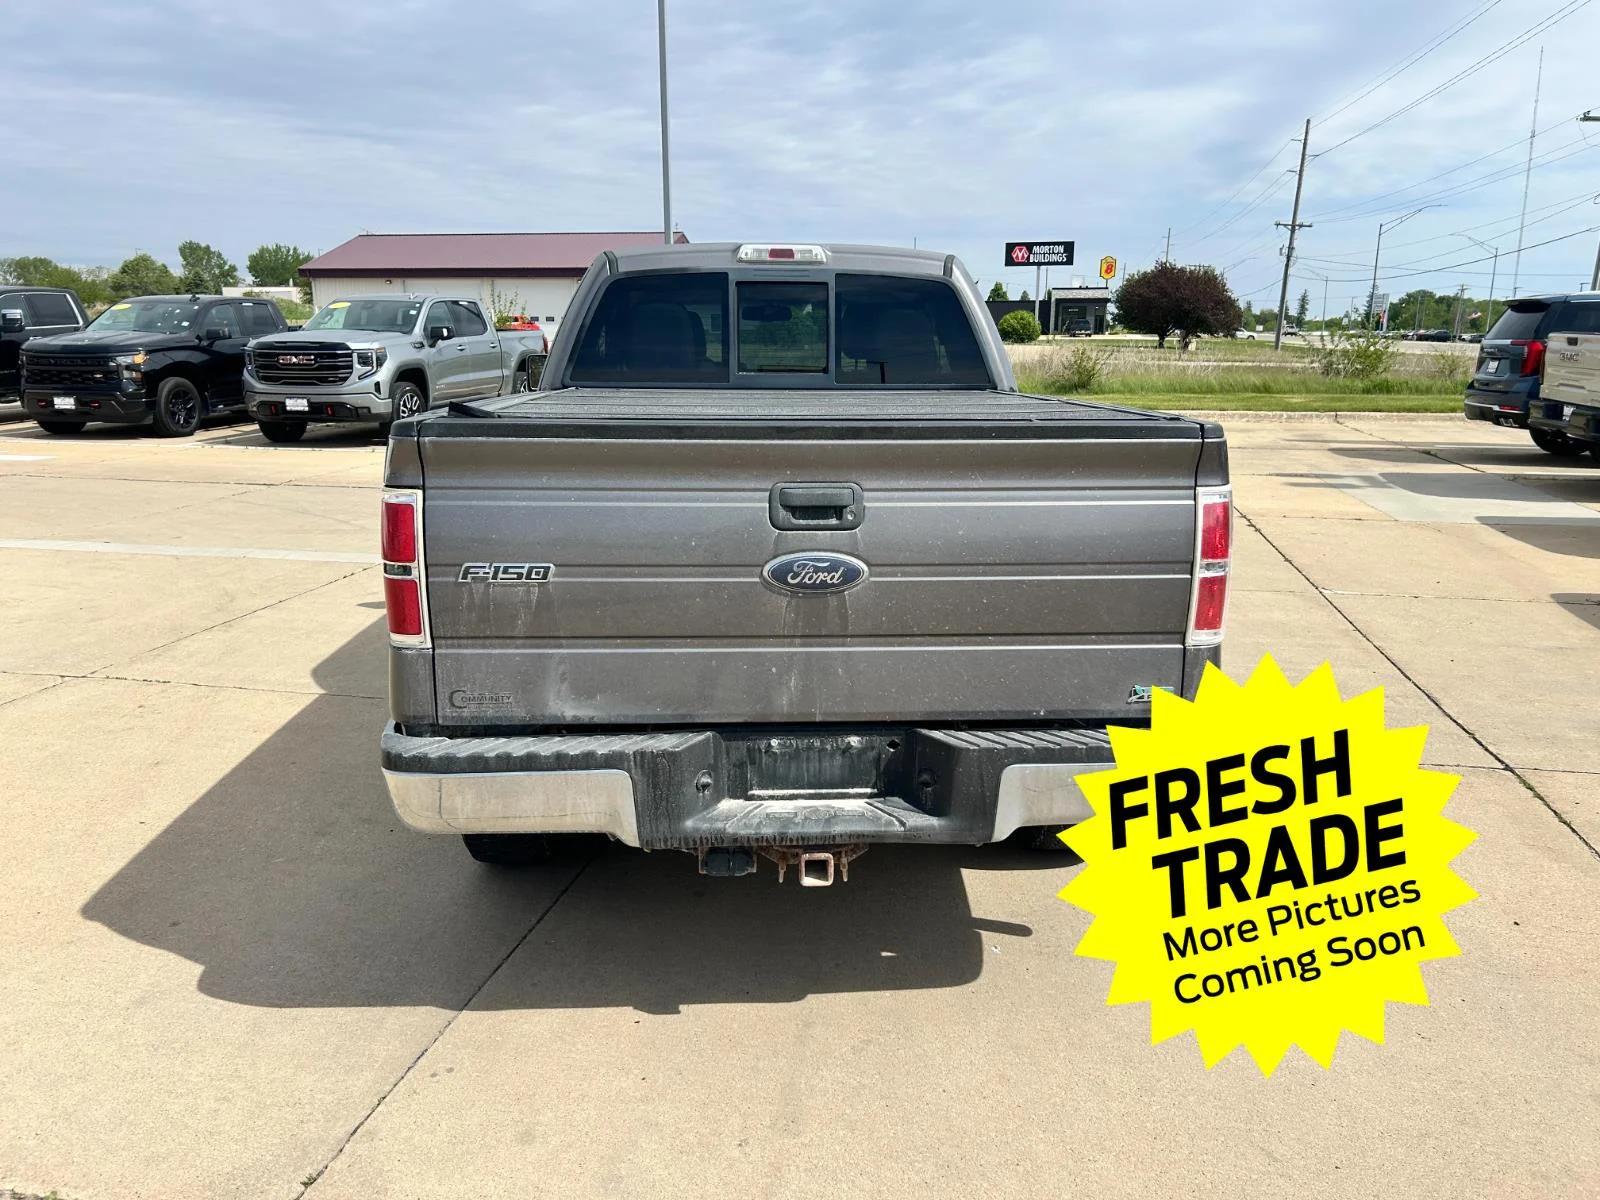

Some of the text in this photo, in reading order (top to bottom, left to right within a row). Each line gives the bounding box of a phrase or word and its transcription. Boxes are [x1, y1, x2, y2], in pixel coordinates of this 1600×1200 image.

[1032, 245, 1064, 254] MORTON
[1029, 253, 1067, 263] BUILDINGS
[1104, 263, 1114, 275] 8
[278, 355, 315, 364] GMC
[458, 562, 555, 582] F-150
[787, 560, 843, 584] Ford
